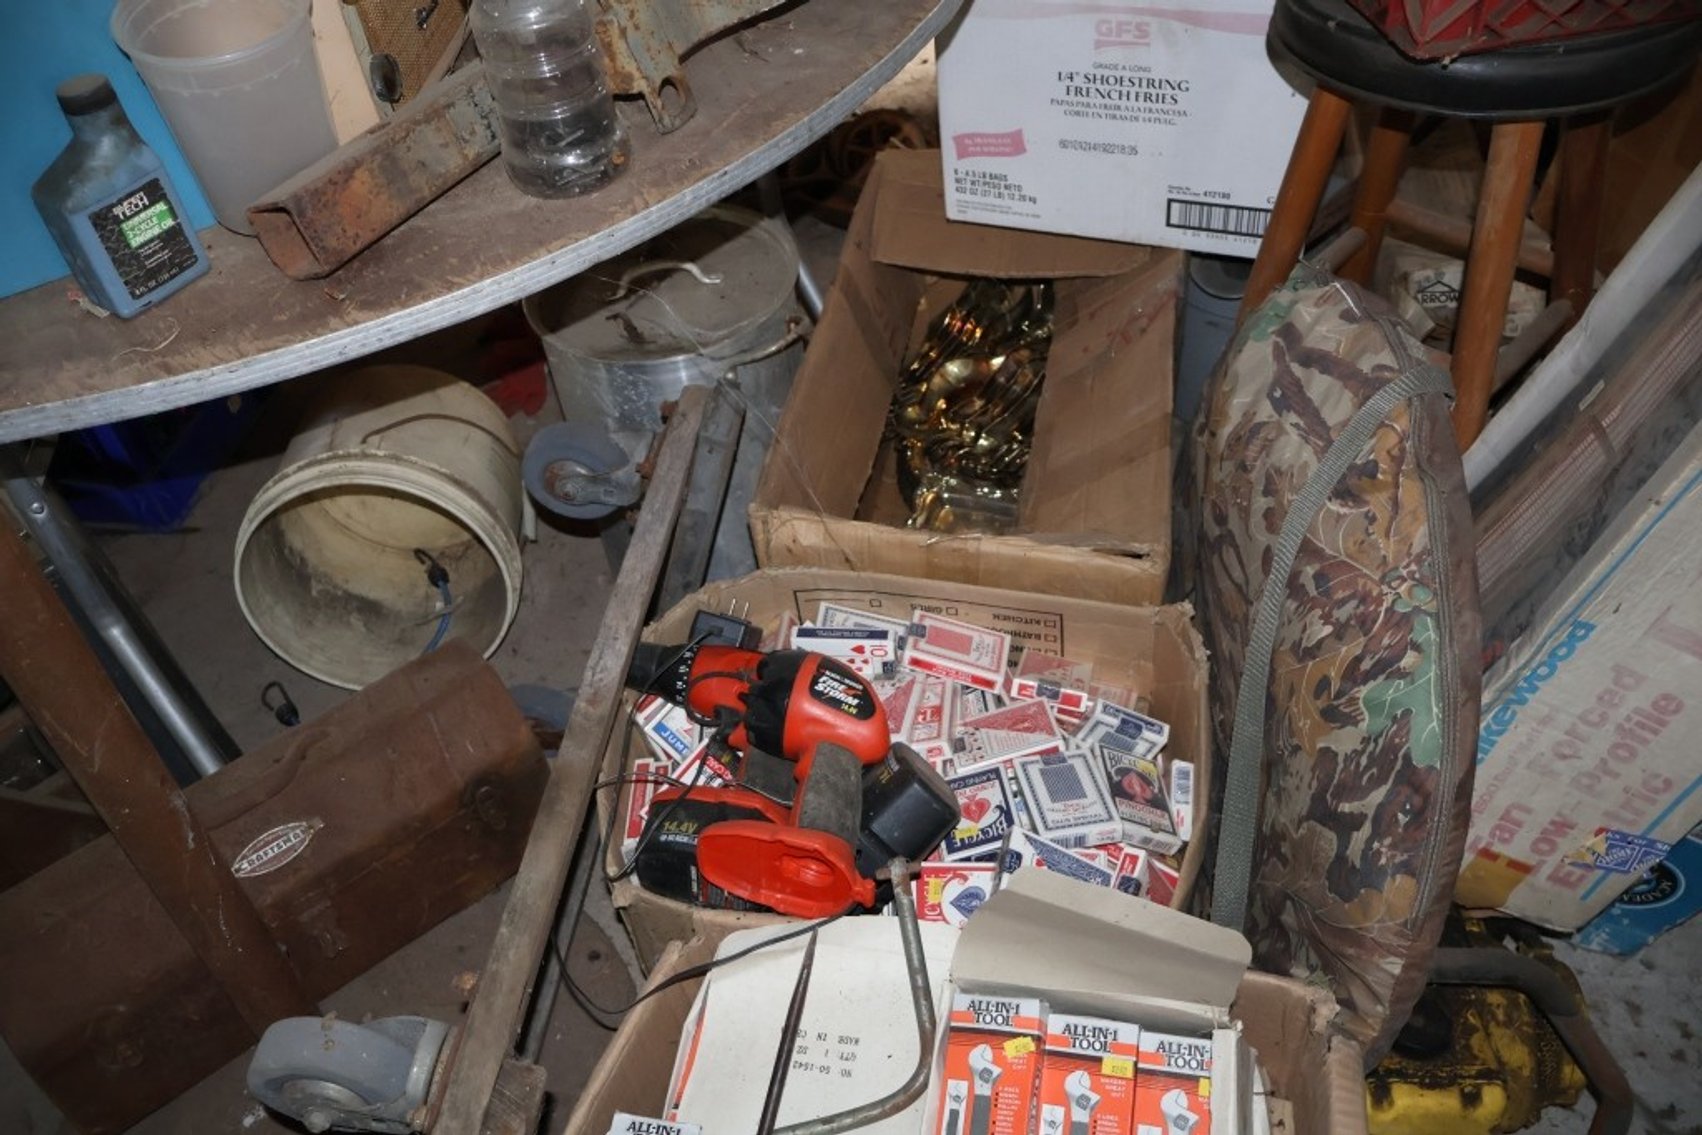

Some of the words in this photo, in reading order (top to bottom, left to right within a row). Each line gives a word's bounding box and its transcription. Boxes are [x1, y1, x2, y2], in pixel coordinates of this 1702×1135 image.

[1093, 19, 1151, 40] GFS
[1083, 72, 1190, 93] SHOESTRING
[1065, 85, 1131, 102] FRENCH
[1134, 91, 1179, 105] FRIES
[115, 197, 149, 220] TECH
[1420, 292, 1459, 305] RROW
[992, 612, 1042, 627] KITCHEN
[813, 683, 861, 706] STORM
[1476, 618, 1597, 766] akewood
[662, 820, 698, 834] 14.4V
[967, 999, 1021, 1015] ALL-IN-1
[973, 1011, 1014, 1027] TOOL
[815, 1032, 828, 1042] IN
[838, 1035, 860, 1046] MADE
[1061, 1022, 1118, 1042] ALL-IN-1
[1070, 1036, 1112, 1053] TOOL
[1165, 1054, 1209, 1072] TOOL
